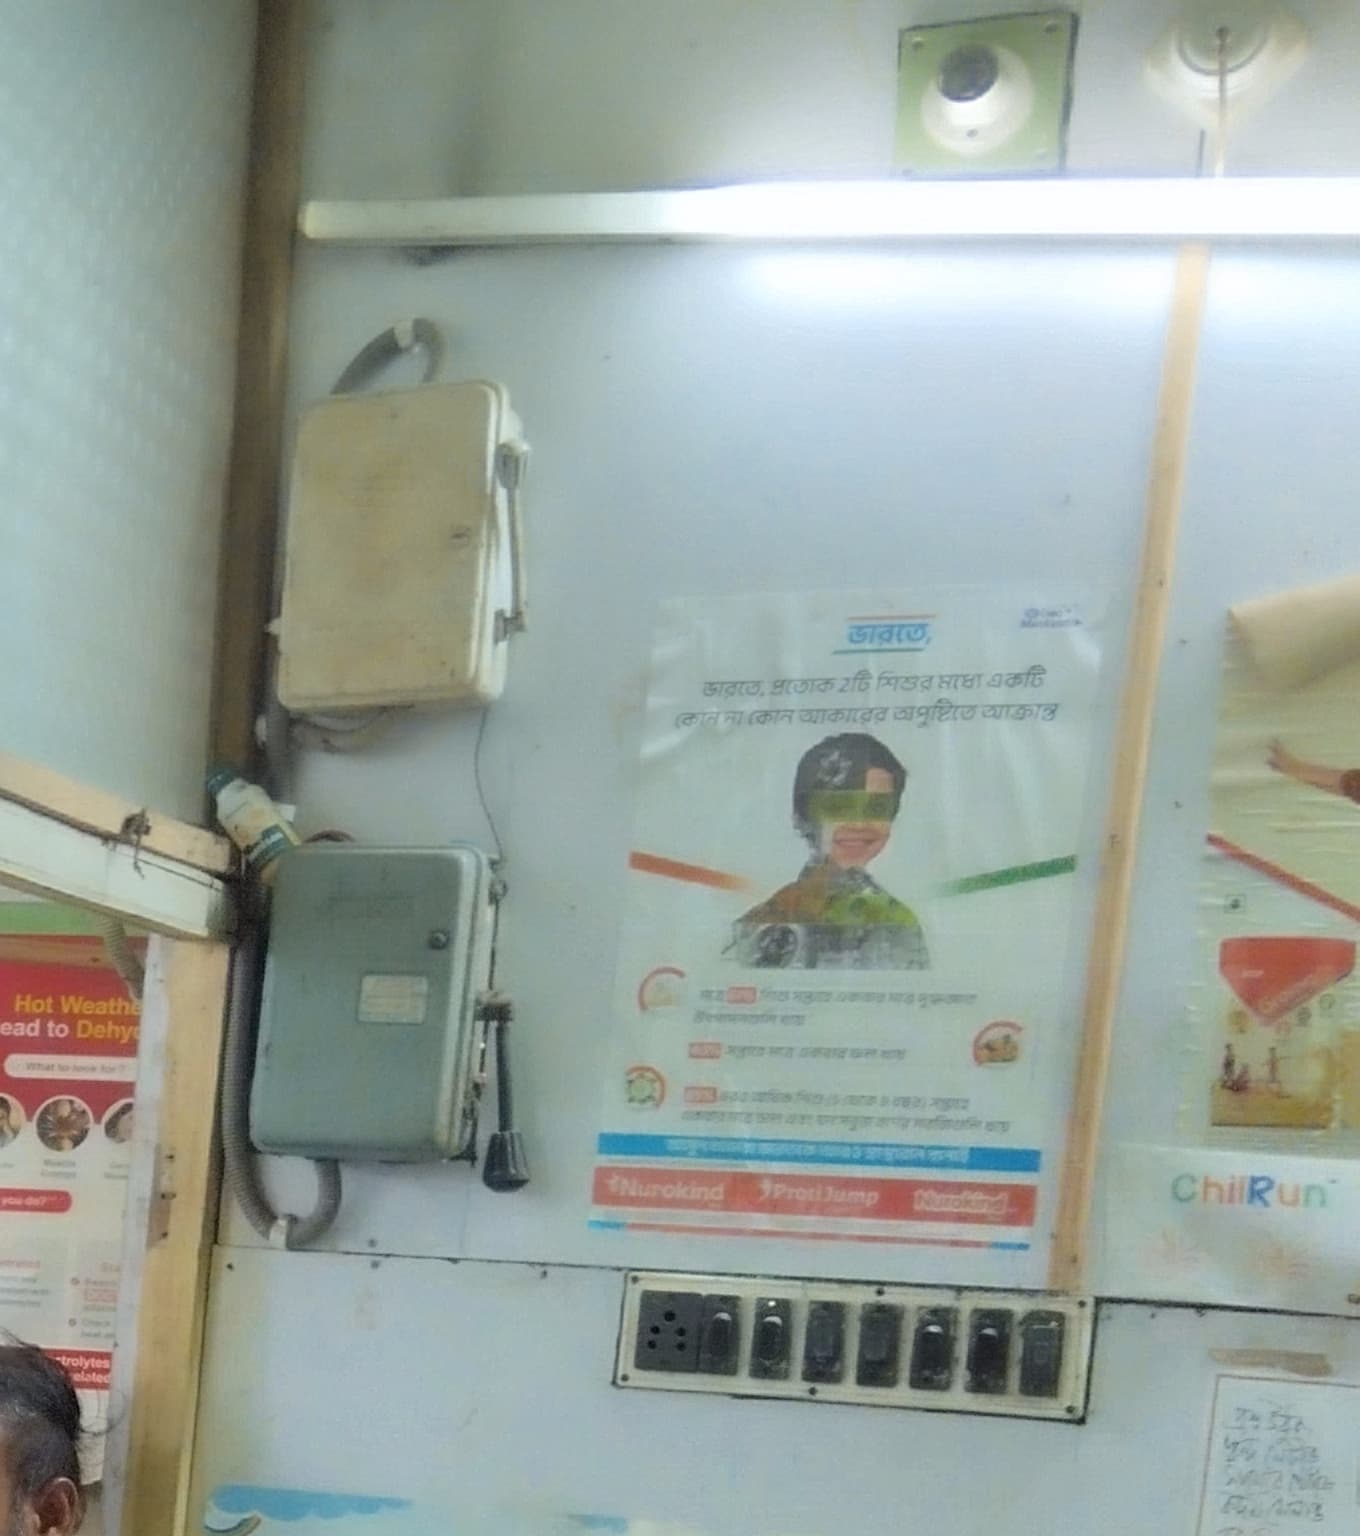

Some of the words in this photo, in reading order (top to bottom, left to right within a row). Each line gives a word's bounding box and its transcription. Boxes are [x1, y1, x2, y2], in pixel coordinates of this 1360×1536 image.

[14, 993, 54, 1015] Hot
[60, 995, 143, 1016] Weathe
[46, 1021, 70, 1038] to
[76, 1020, 141, 1044] Dehy
[56, 1355, 111, 1370] trolytes
